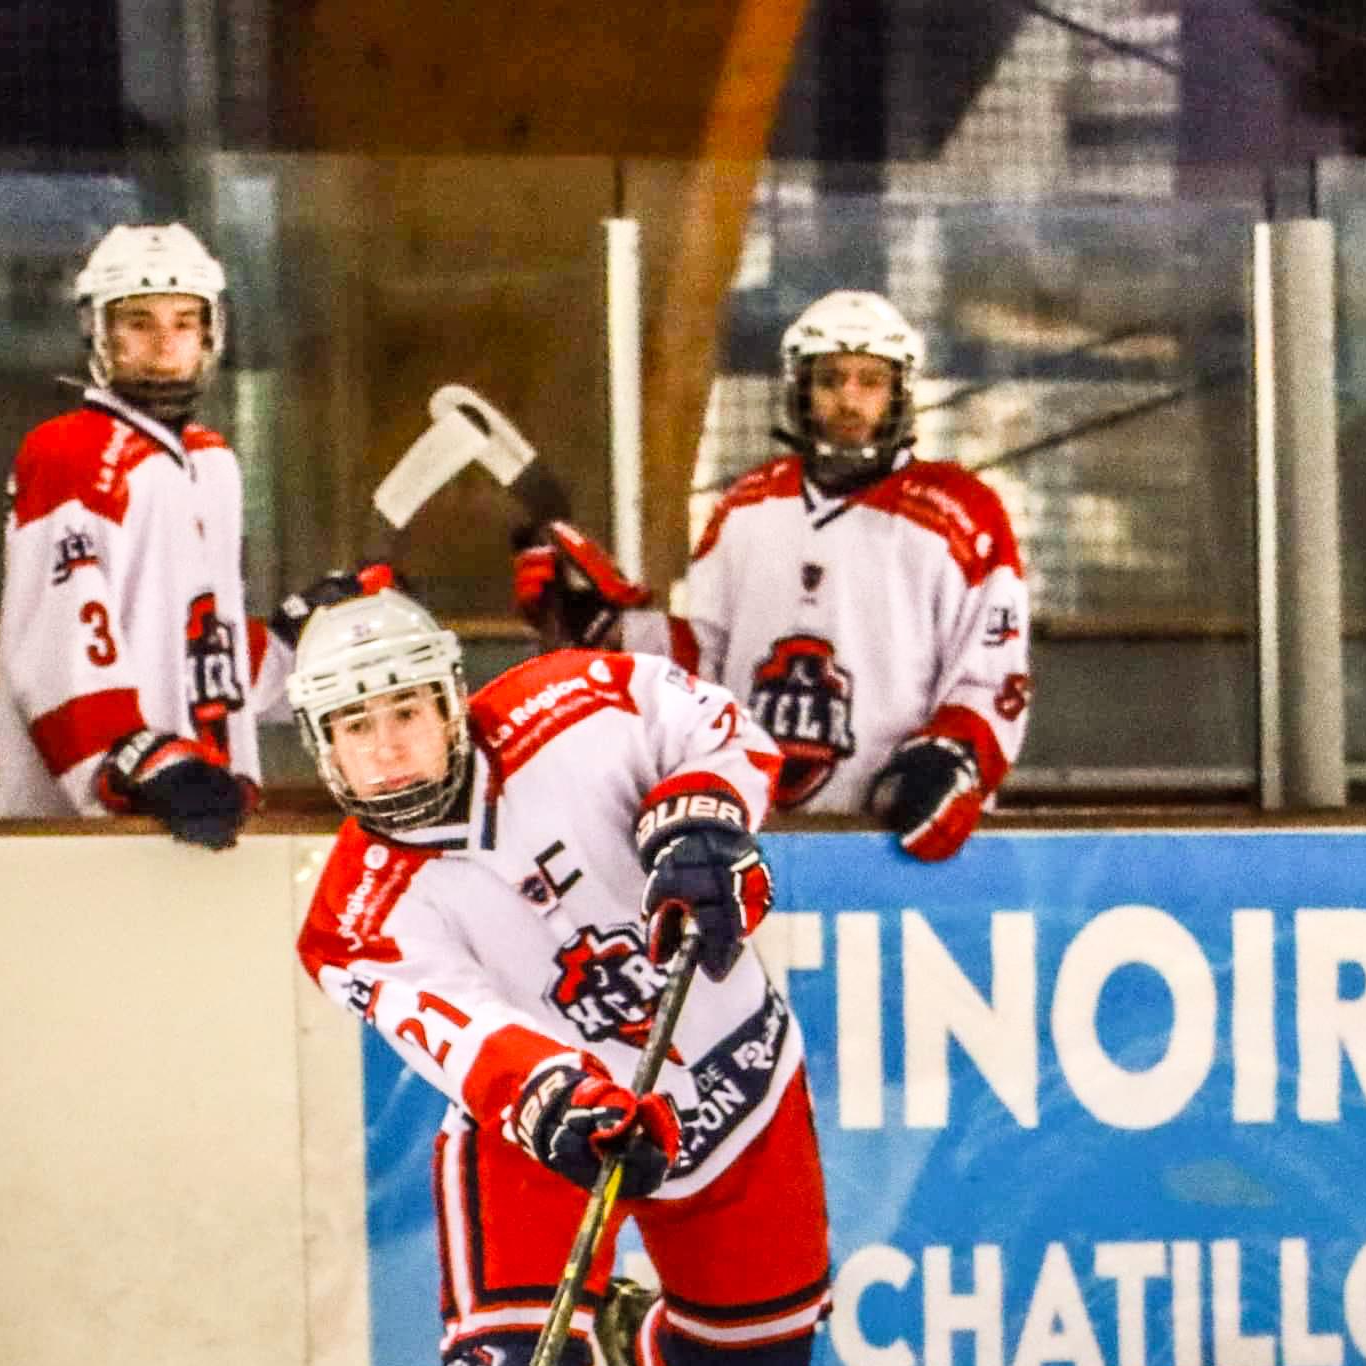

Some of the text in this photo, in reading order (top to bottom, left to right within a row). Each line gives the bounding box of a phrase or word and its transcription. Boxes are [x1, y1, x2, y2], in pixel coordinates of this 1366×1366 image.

[79, 601, 117, 666] 3
[508, 676, 590, 727] Région
[636, 793, 744, 851] AUER
[534, 839, 584, 899] C
[396, 990, 473, 1073] 21
